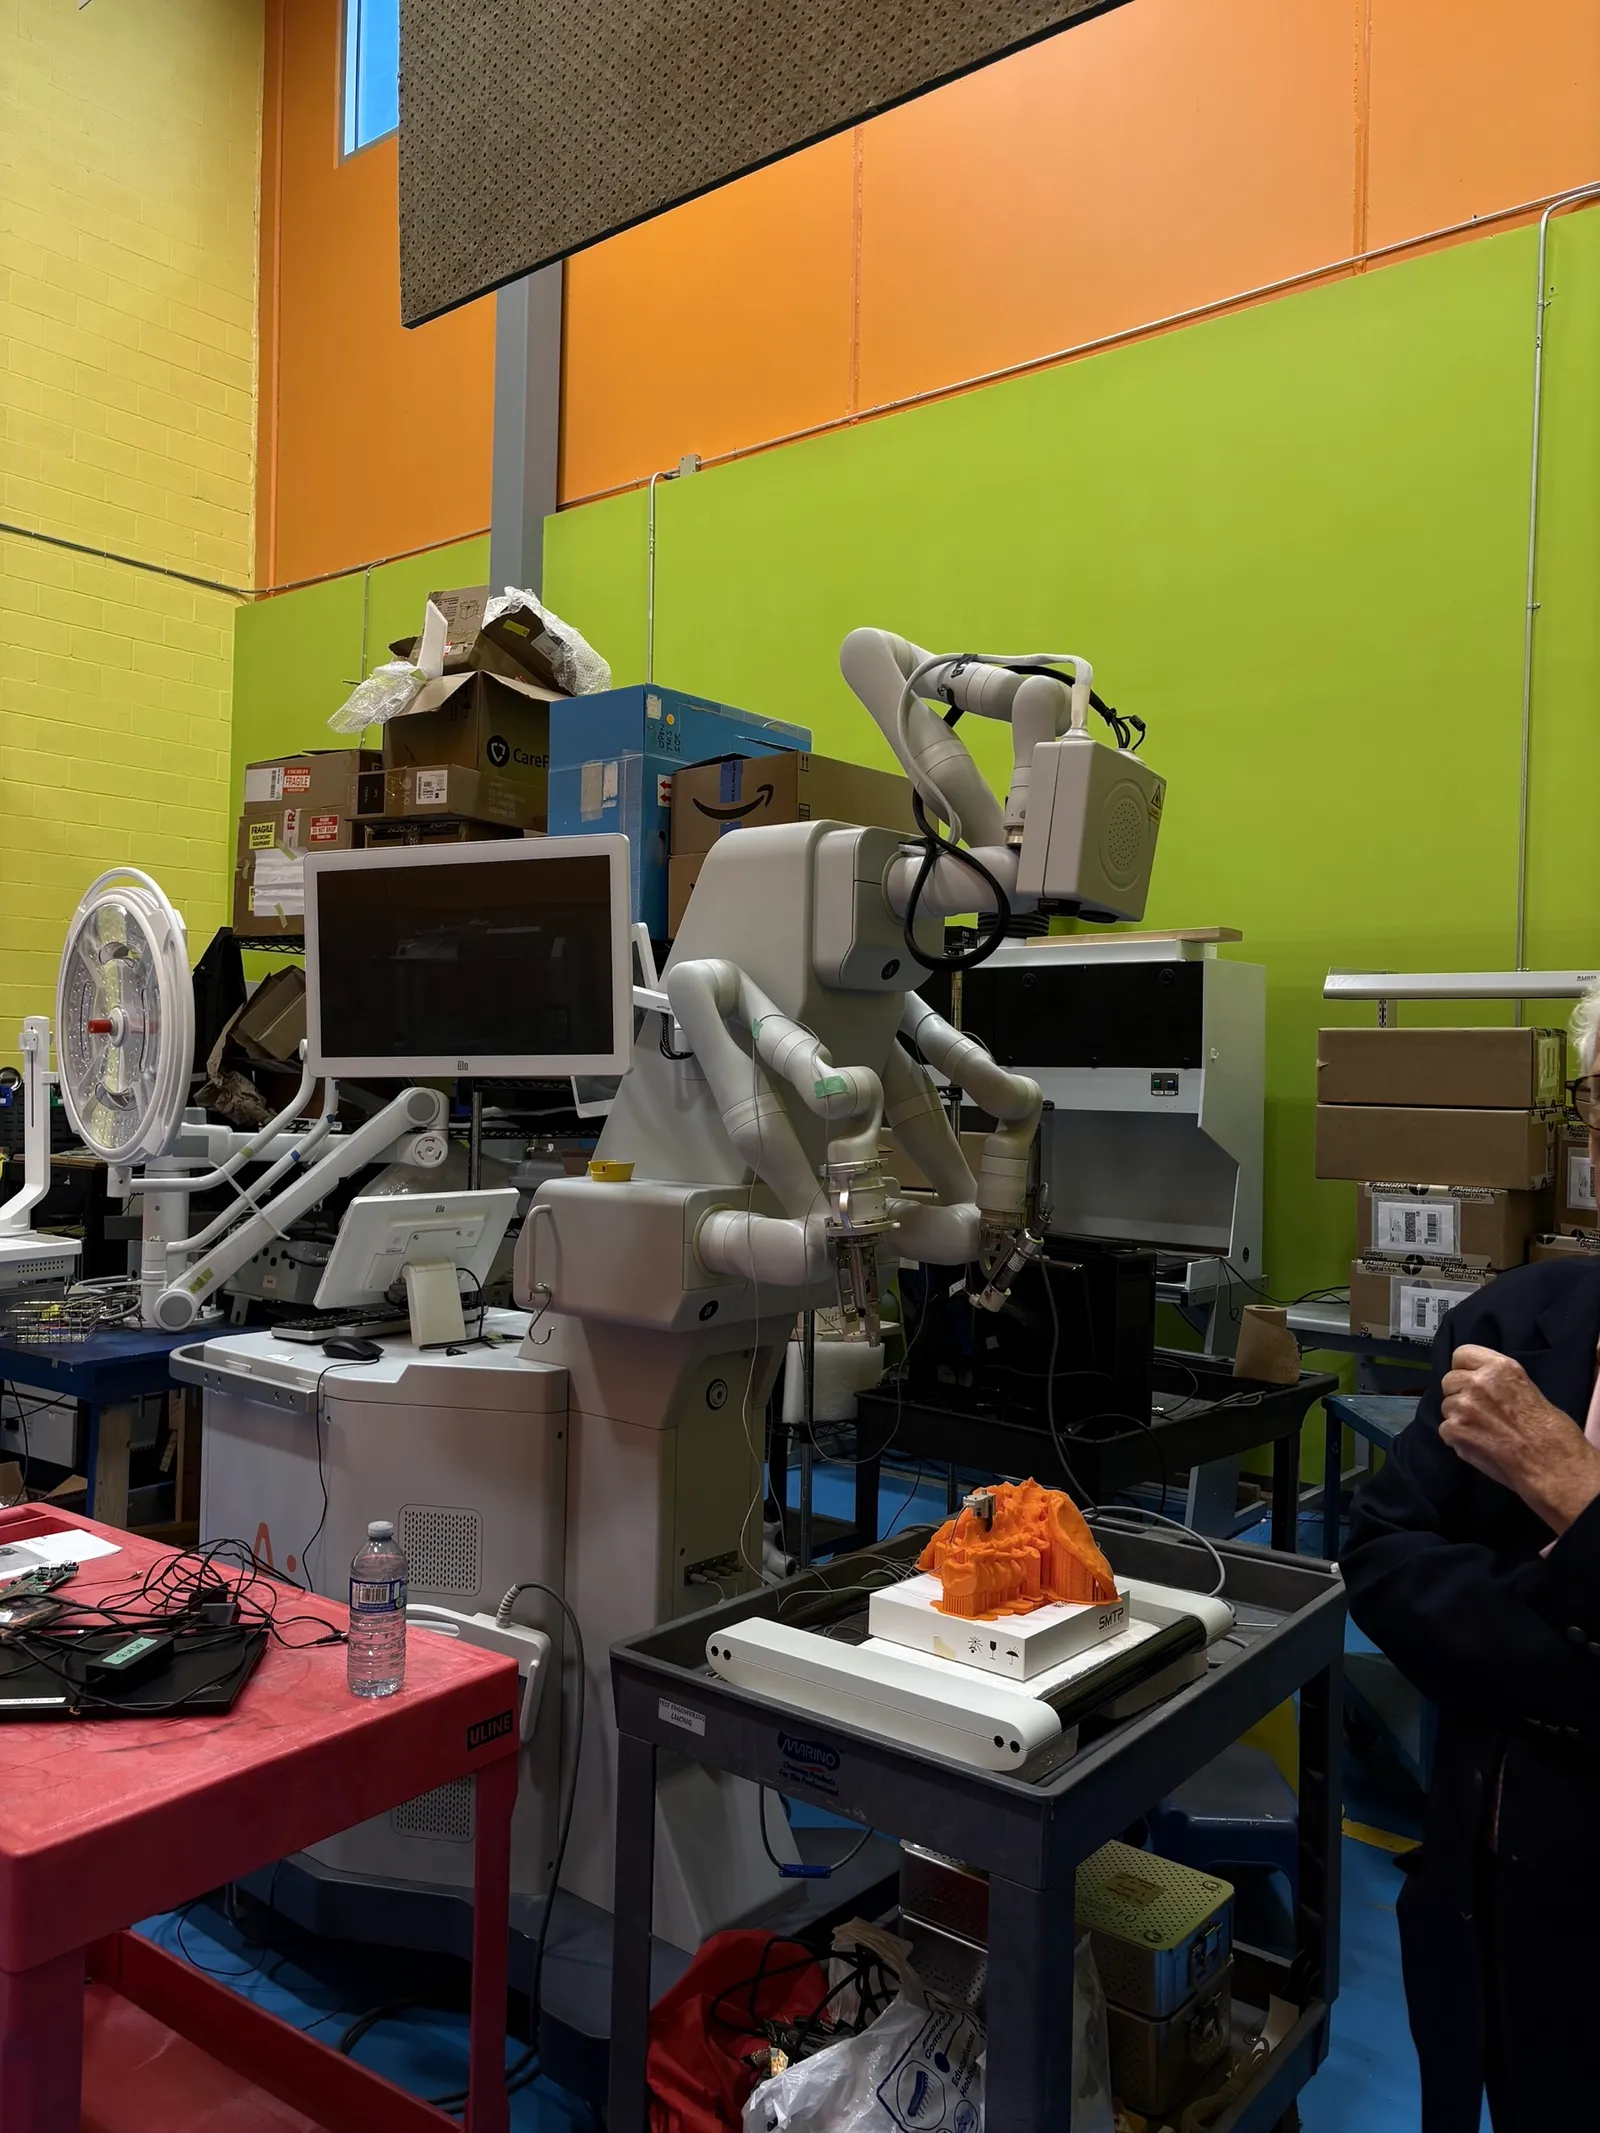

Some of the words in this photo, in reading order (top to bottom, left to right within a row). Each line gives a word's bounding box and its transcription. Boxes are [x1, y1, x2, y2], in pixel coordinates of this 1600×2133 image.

[285, 776, 309, 786] FRAGILE
[251, 825, 274, 834] FRAGILE
[1372, 1187, 1391, 1196] Digital
[1452, 1191, 1471, 1199] Digital
[1366, 1264, 1383, 1273] Digital
[1444, 1271, 1464, 1281] Digital
[1098, 1607, 1124, 1630] SMTP
[659, 1699, 670, 1708] TEST
[671, 1713, 692, 1727] LUONG
[470, 1714, 511, 1746] ULINE
[780, 1738, 837, 1766] MARINO
[951, 2029, 977, 2088] Educational
